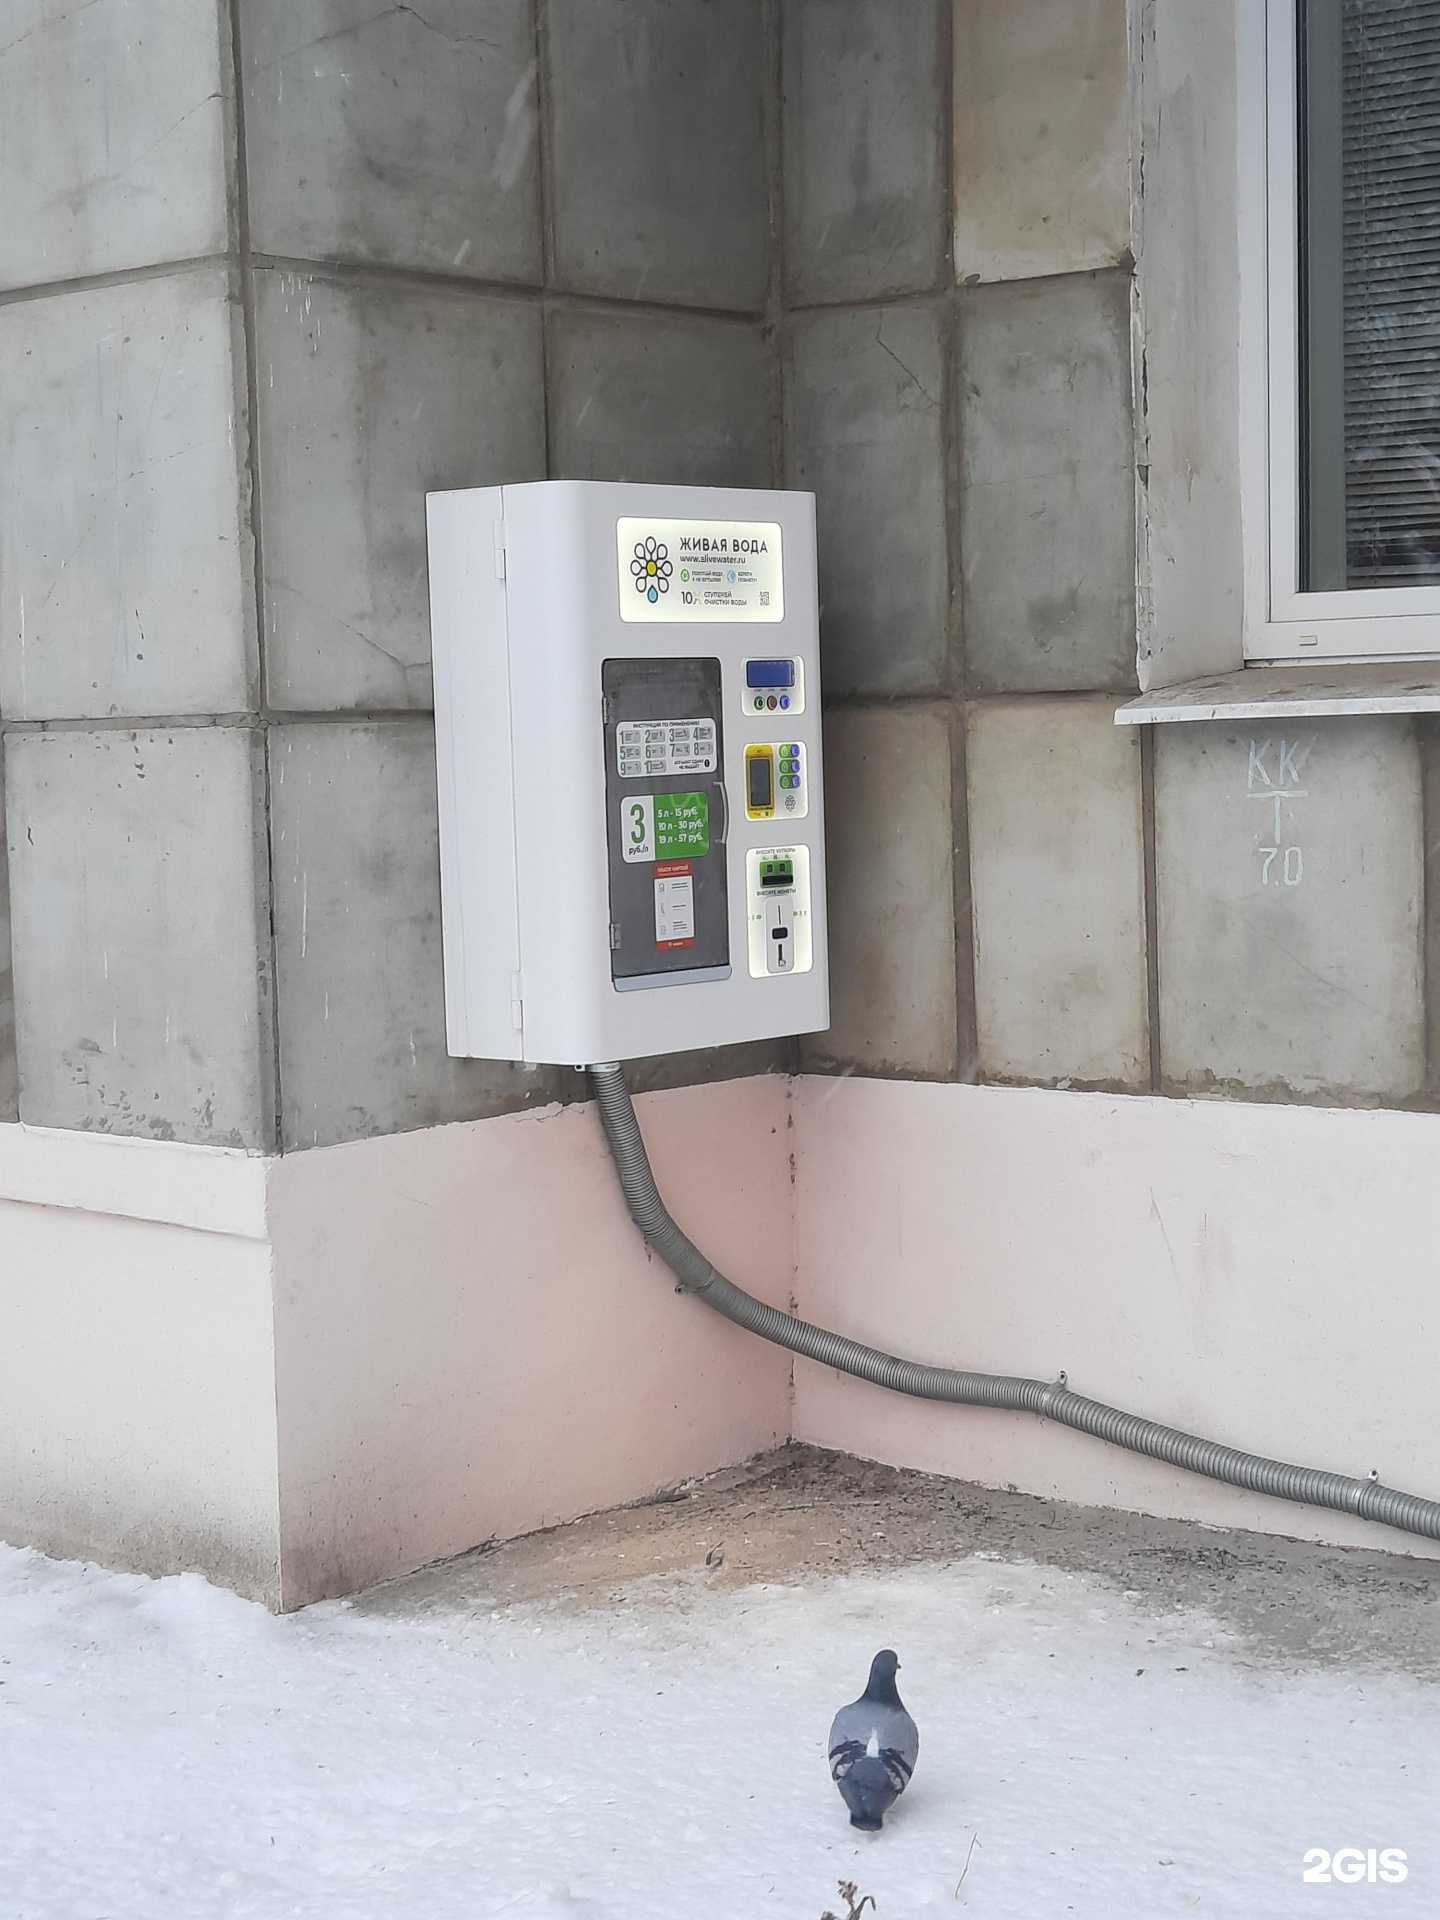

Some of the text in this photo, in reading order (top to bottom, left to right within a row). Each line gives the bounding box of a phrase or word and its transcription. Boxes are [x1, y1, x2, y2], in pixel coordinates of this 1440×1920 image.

[680, 537, 768, 555] ЖИВАЯ ВОДА
[681, 591, 693, 604] 10
[619, 731, 624, 745] 1
[645, 729, 651, 743] 2
[669, 728, 675, 742] 3
[693, 727, 699, 741] 4
[620, 746, 626, 760] 5
[646, 745, 652, 758] 6
[669, 743, 675, 757] 7
[694, 742, 700, 756] 8
[620, 762, 626, 775] 9
[658, 810, 663, 818] 5
[675, 808, 682, 816] 15
[630, 803, 646, 844] 3
[678, 820, 687, 829] 30
[678, 834, 687, 842] 57
